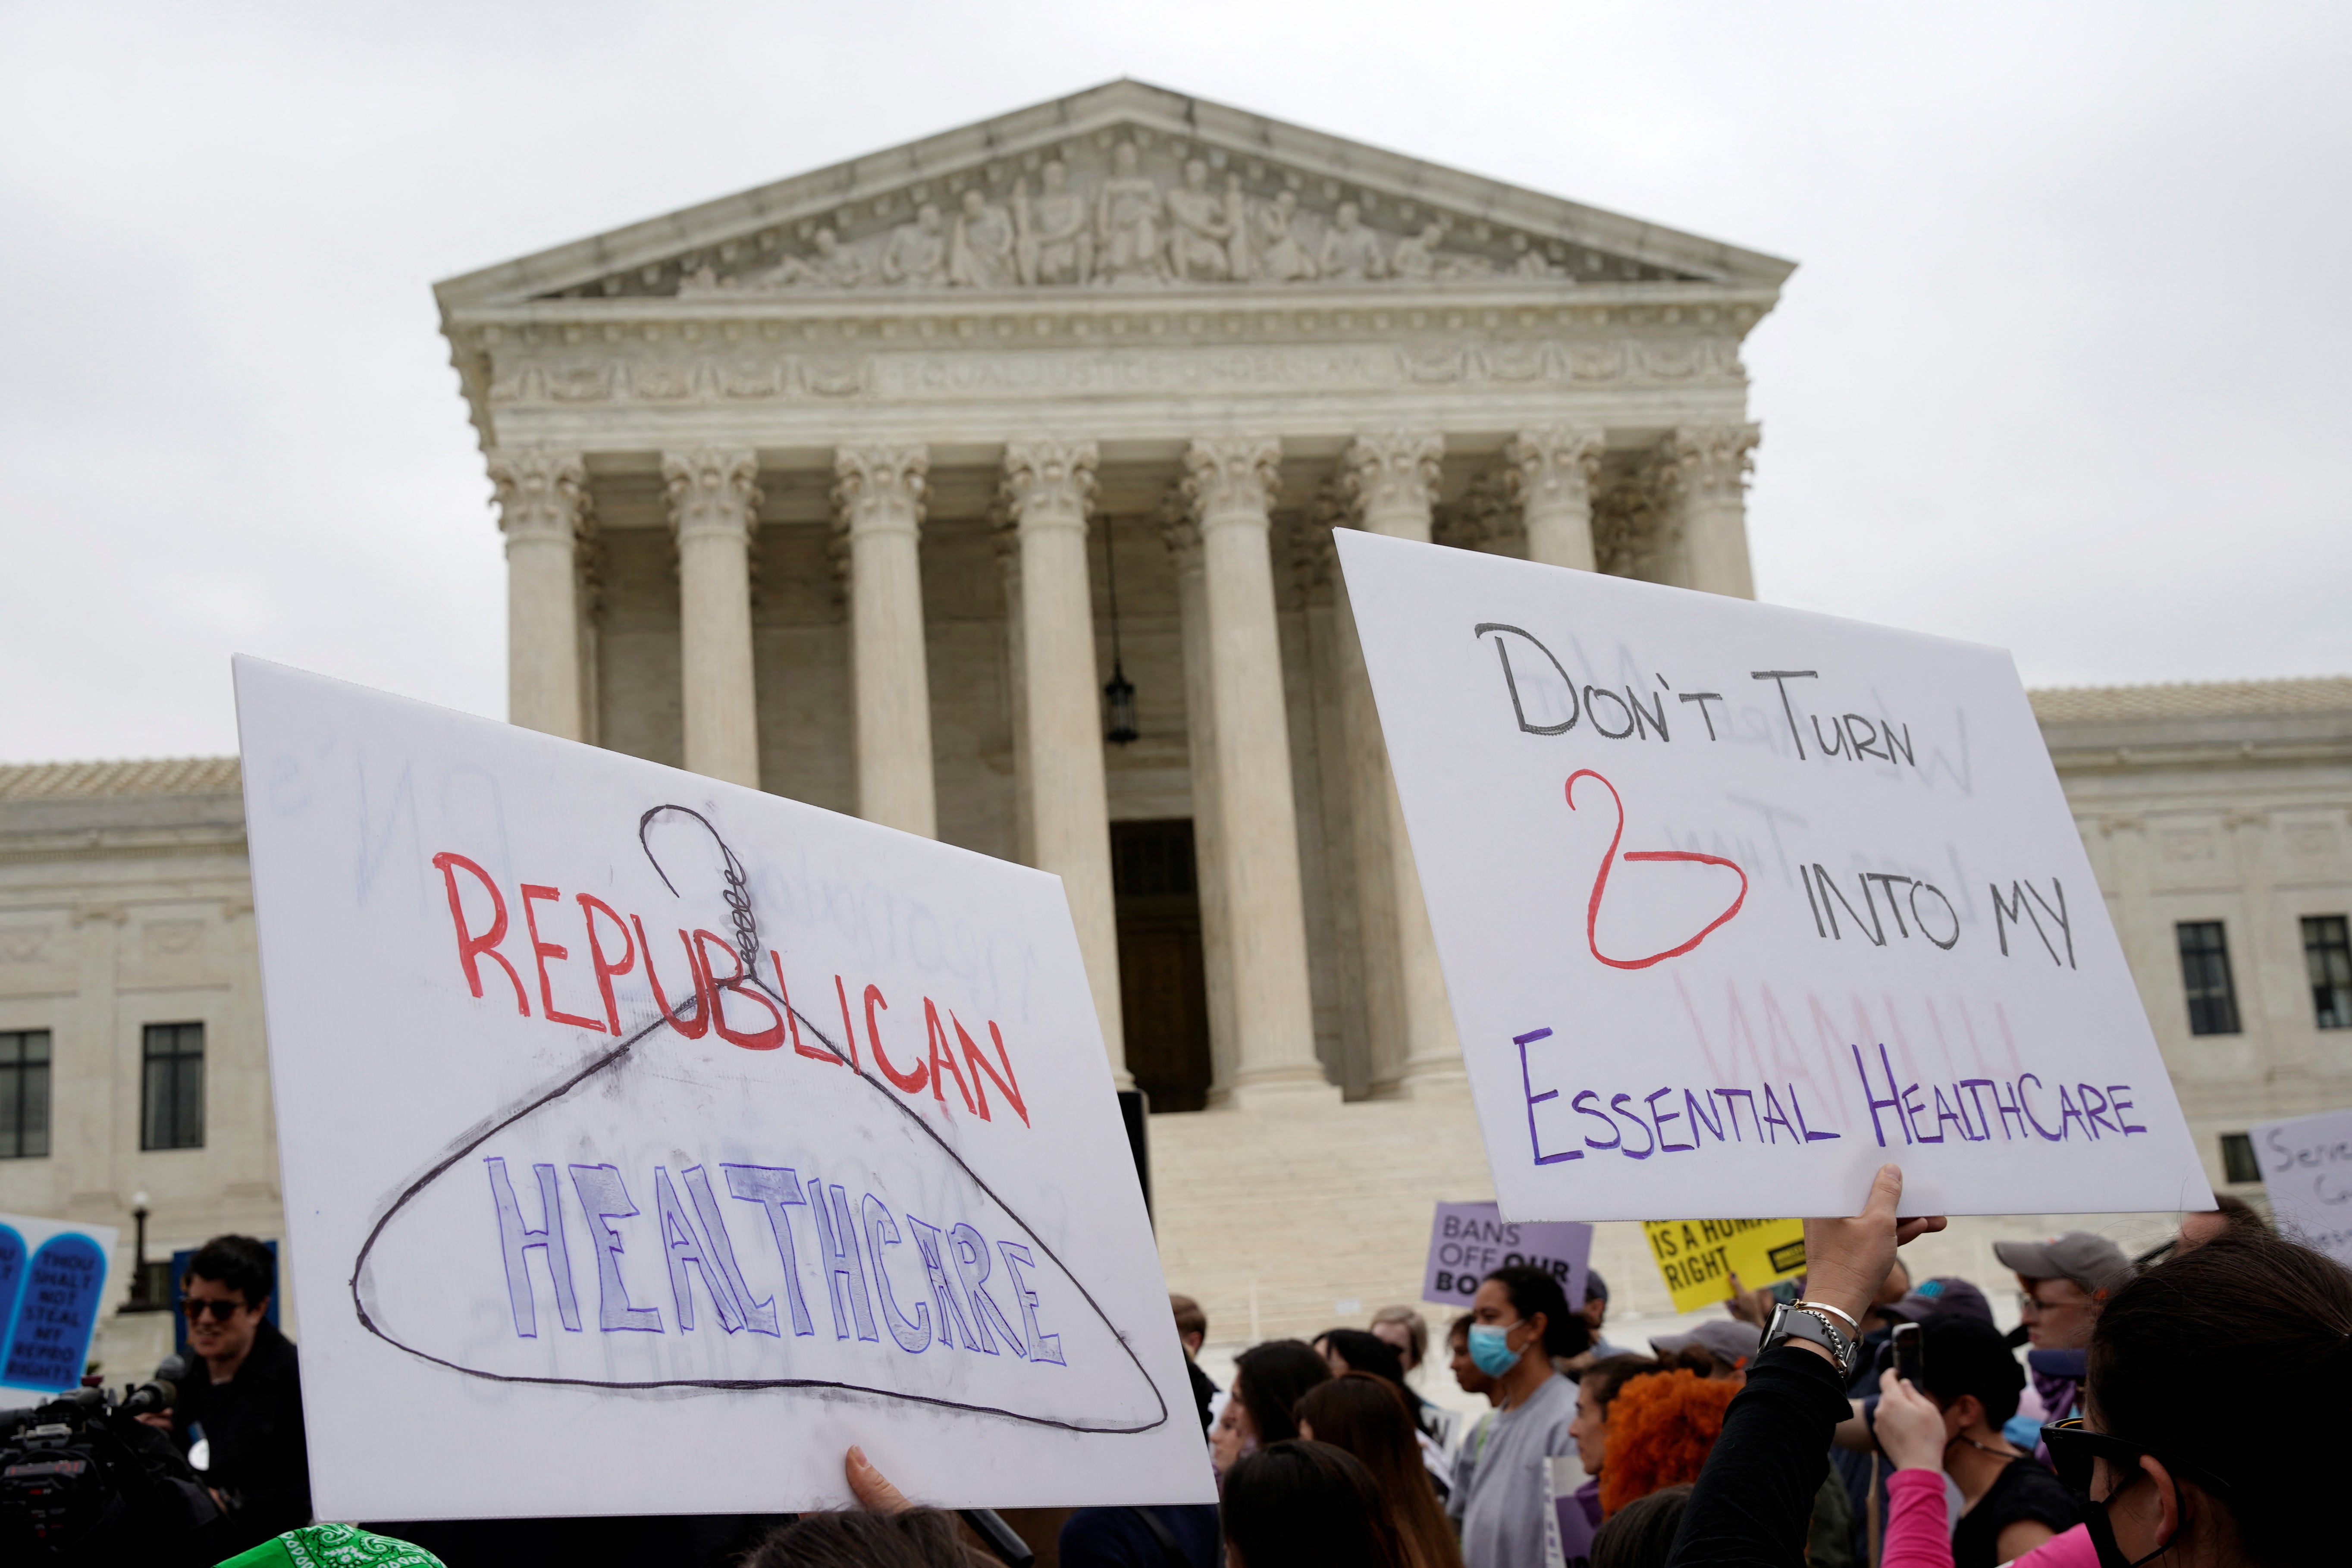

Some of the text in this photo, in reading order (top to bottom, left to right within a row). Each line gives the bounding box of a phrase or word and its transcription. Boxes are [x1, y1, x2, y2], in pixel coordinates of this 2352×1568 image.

[1800, 864, 2076, 969] INTO MY
[433, 852, 1030, 1128] REPUBLICAN
[1513, 1028, 2147, 1165] ESSENTIAL HEALTHCARE
[1443, 1214, 1522, 1248] BANS
[1652, 1229, 1679, 1259] IS
[1682, 1222, 1700, 1250] A
[483, 1157, 1066, 1366] HEALTHCARE
[1439, 1242, 1499, 1272] OFF
[1664, 1245, 1730, 1291] RIGHT
[38, 1290, 76, 1305] NOT
[1435, 1270, 1479, 1296] BO
